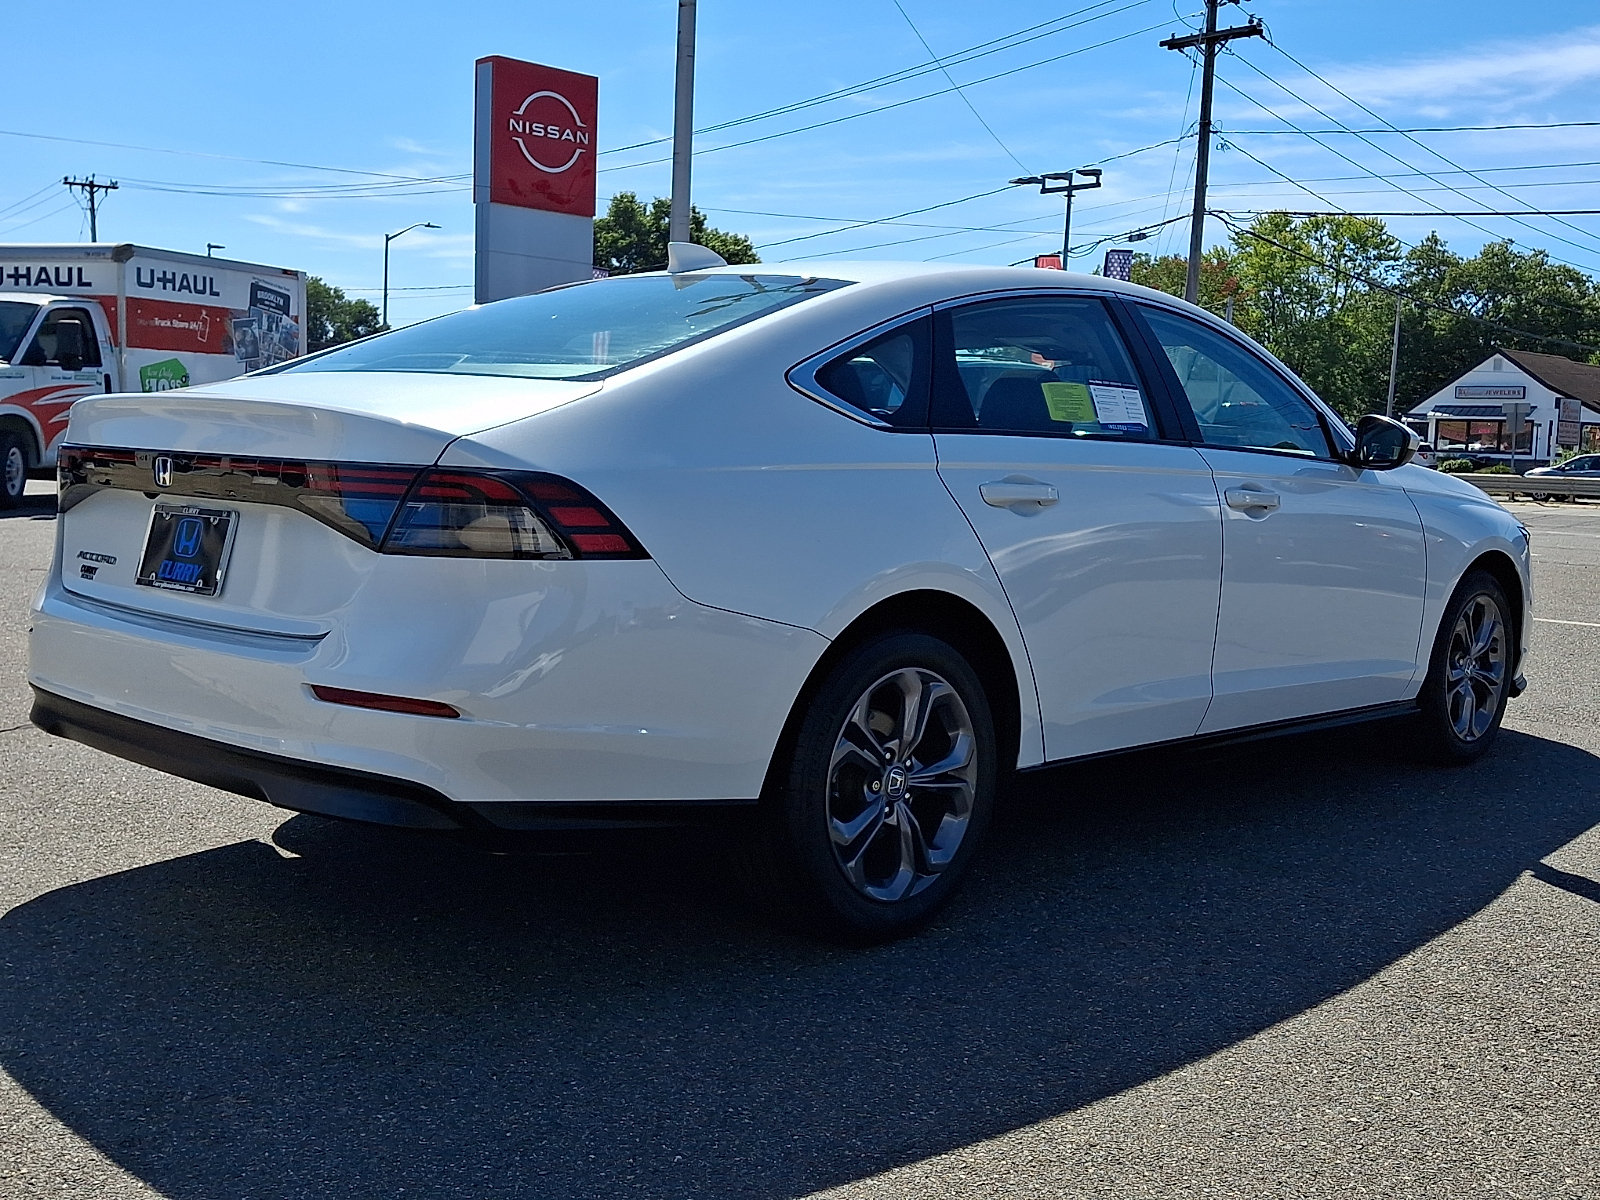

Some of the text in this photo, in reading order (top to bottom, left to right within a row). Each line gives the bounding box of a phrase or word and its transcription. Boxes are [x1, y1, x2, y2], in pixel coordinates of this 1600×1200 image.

[509, 118, 589, 145] NISSAN
[0, 266, 92, 287] -HAUL
[136, 266, 220, 297] U-HAUL
[257, 290, 284, 306] BROOKLYN
[153, 317, 171, 327] Truck
[182, 507, 200, 516] CURRY
[76, 550, 117, 565] ACCORD
[158, 560, 204, 582] CURRY
